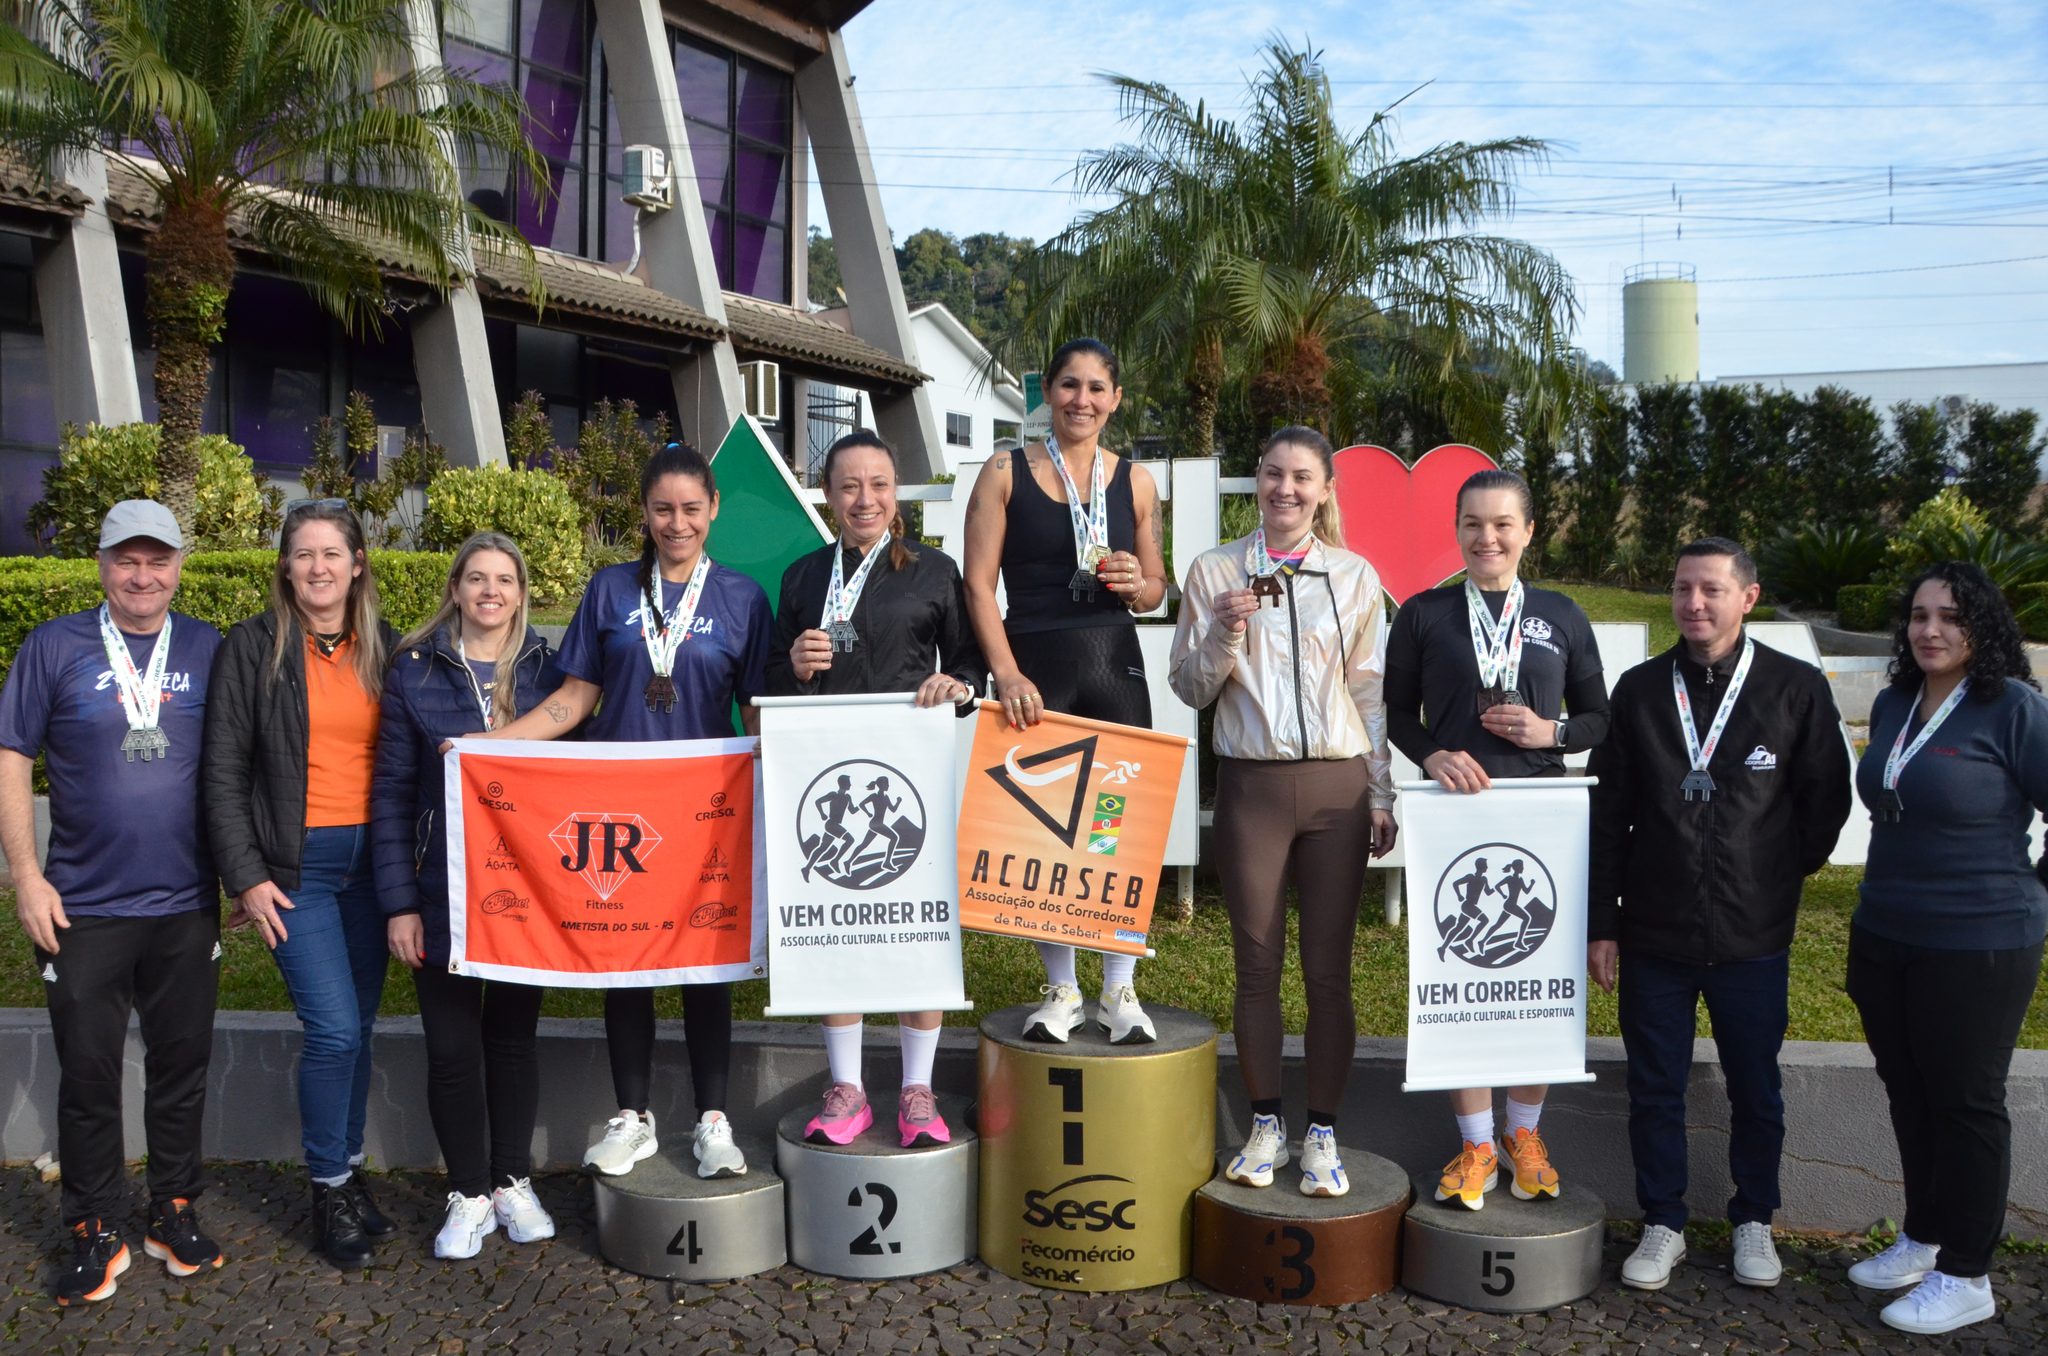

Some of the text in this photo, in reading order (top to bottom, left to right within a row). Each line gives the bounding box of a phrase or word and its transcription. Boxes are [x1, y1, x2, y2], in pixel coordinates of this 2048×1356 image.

[695, 807, 736, 822] CRESOL
[561, 821, 648, 873] JR
[485, 858, 520, 872] ÁGATA
[971, 849, 1144, 909] ACORSEB
[586, 900, 624, 910] Fitness
[779, 901, 950, 928] VEM CORRER RB
[965, 886, 1136, 926] Associação dos Corredores
[561, 921, 609, 932] AMETISTA
[612, 923, 627, 932] DO
[631, 922, 650, 931] SUL
[662, 921, 674, 930] RS
[780, 931, 951, 948] ASSOCIAÇÃO CULTURAL E ESPORTIVA
[994, 913, 1101, 940] de Rua de Seberi
[1417, 978, 1576, 1006] VEM CORRER RB
[1417, 1007, 1575, 1025] ASSOCIAÇÃO CULTURAL E ESPORTIVA
[1048, 1067, 1084, 1165] 1
[848, 1182, 902, 1255] 2
[1022, 1184, 1136, 1232] Sesc
[666, 1220, 703, 1264] 4
[1021, 1238, 1135, 1263] Fecomércio
[1022, 1261, 1081, 1284] Senac
[1264, 1225, 1315, 1300] 3
[1481, 1250, 1515, 1297] 5
